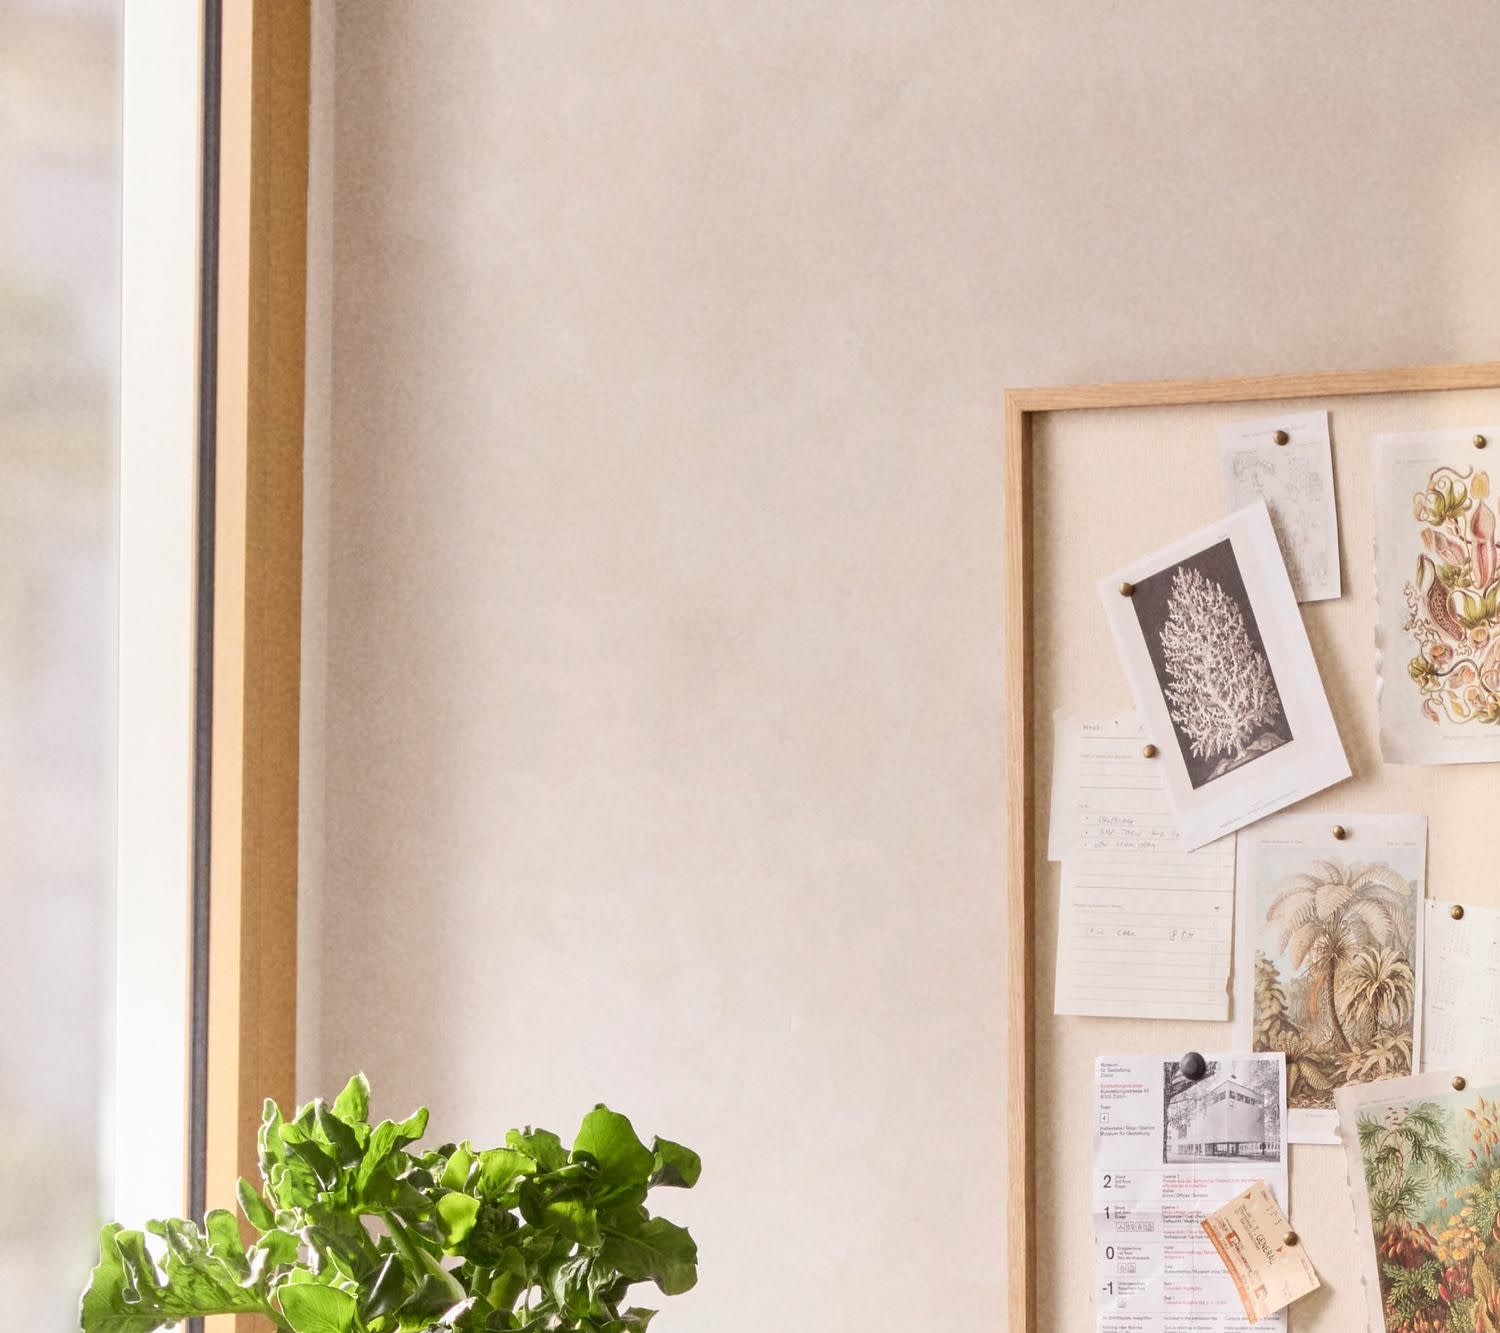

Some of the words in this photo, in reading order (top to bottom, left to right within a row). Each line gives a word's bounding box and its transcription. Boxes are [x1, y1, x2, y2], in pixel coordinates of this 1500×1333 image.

[1103, 1174, 1112, 1188] 2
[1104, 1206, 1110, 1219] 1
[1105, 1246, 1114, 1260] 0
[1102, 1281, 1113, 1295] -1
